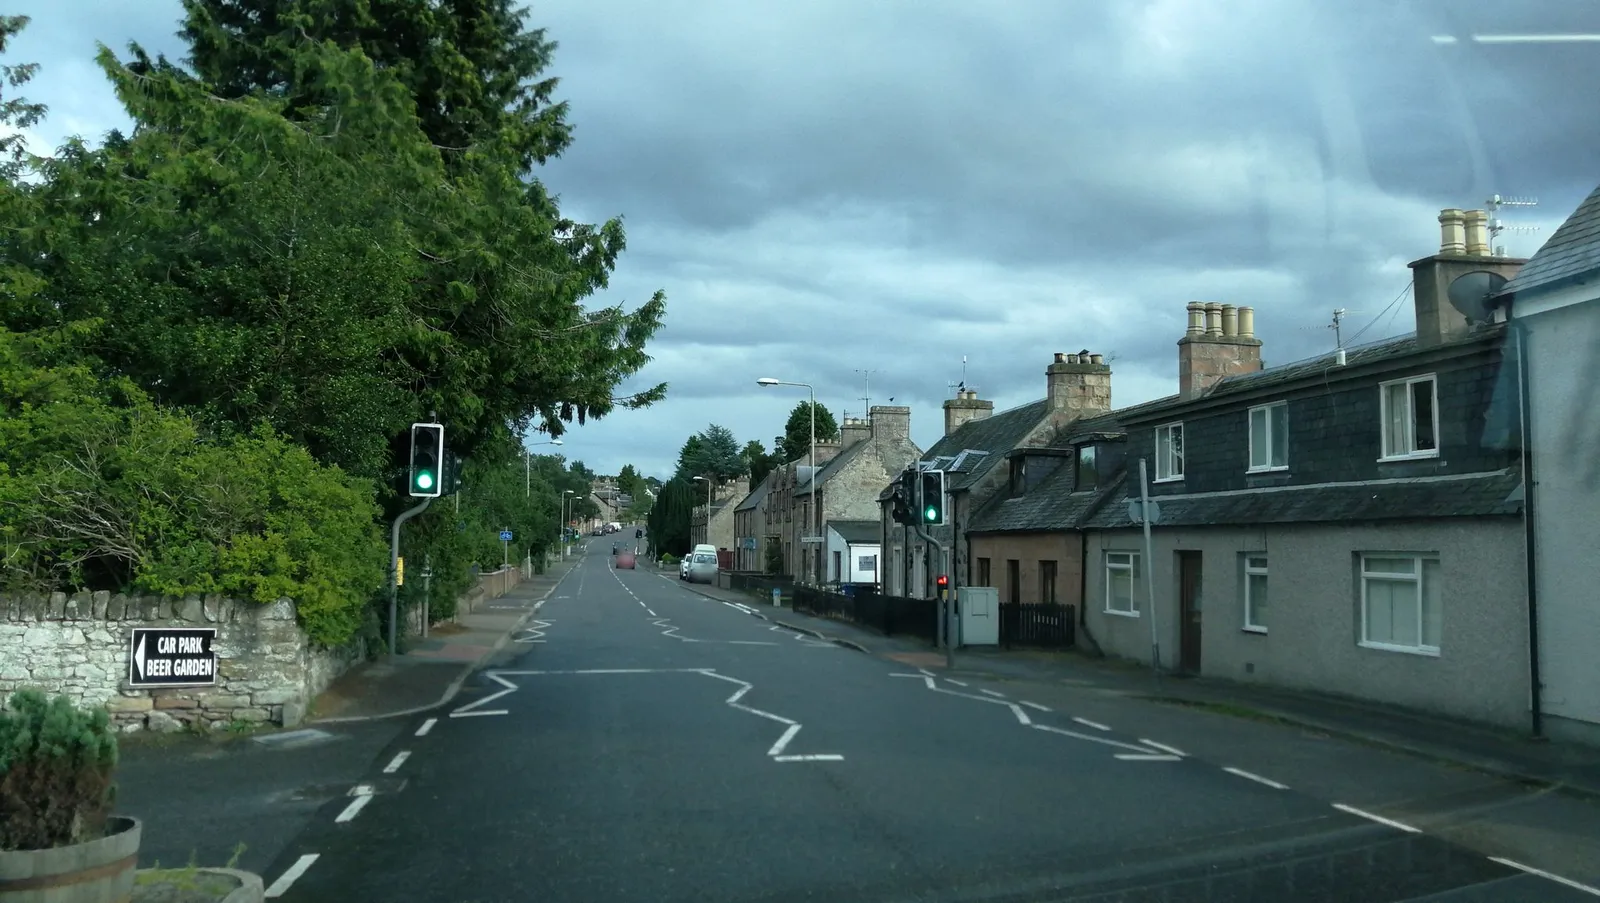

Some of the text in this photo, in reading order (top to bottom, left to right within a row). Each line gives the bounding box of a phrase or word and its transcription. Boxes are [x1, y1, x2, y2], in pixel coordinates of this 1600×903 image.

[157, 637, 203, 654] CAR PARK
[147, 659, 212, 676] BEER GARDEN
